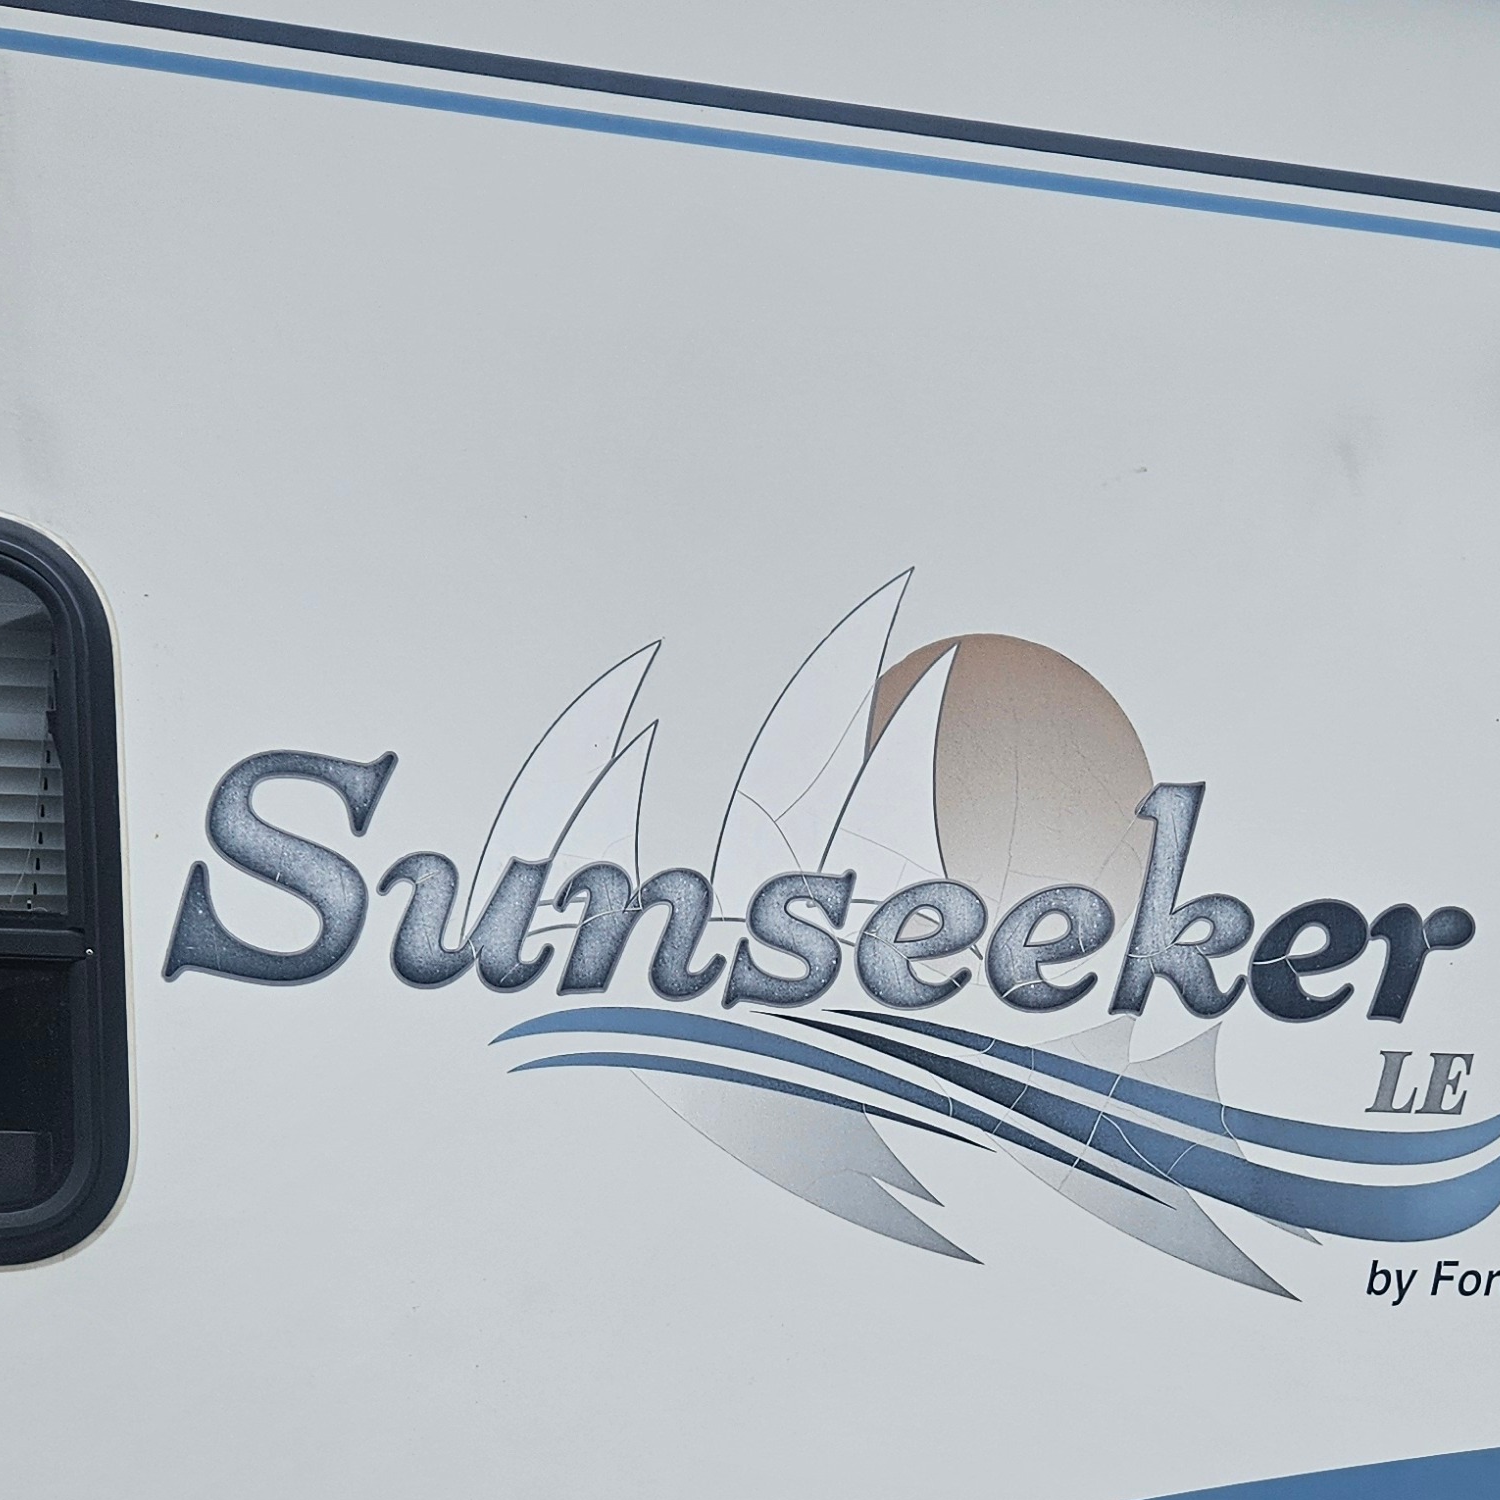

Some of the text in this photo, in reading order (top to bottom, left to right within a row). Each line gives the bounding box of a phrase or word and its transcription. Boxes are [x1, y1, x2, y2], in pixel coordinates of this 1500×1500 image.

[161, 747, 1478, 1025] Sunseeker
[1364, 1050, 1475, 1115] LE
[1366, 1259, 1418, 1306] by
